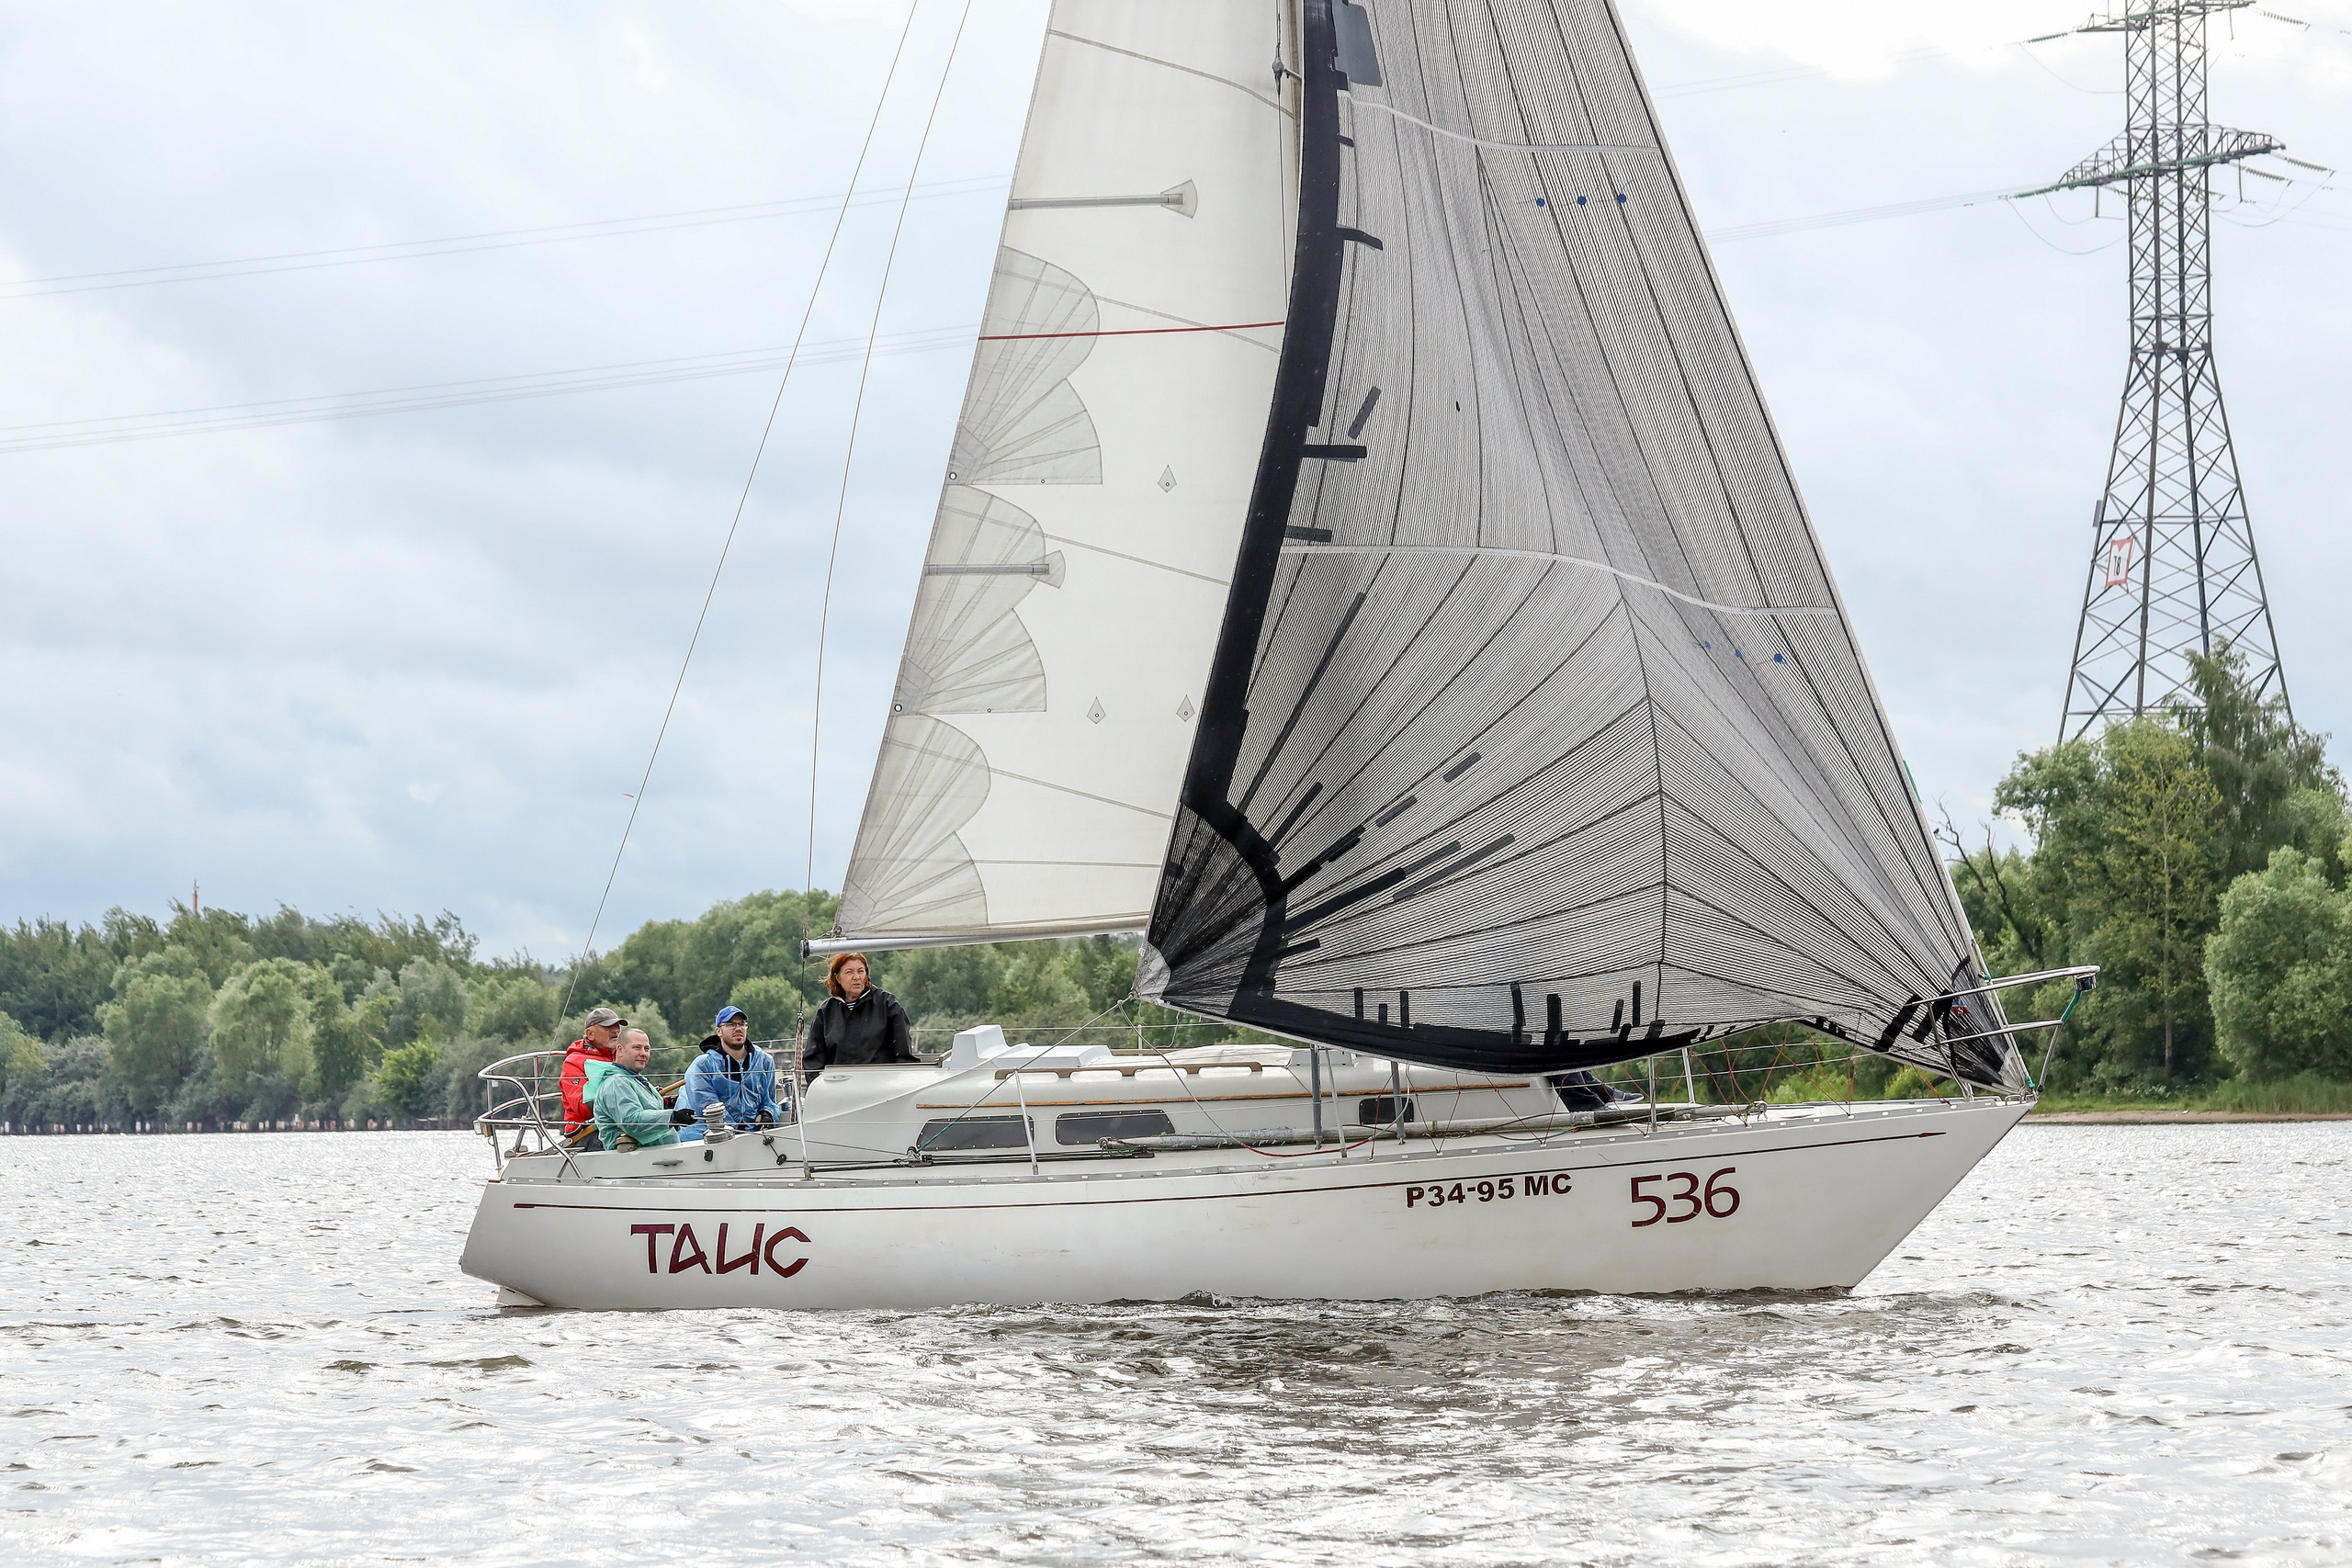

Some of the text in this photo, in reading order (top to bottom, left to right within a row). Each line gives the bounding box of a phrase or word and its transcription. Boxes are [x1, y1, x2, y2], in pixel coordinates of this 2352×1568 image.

[2113, 555, 2121, 576] 18
[1406, 1173, 1573, 1208] Р34-95 МС
[1630, 1167, 1741, 1227] 536
[630, 1223, 812, 1278] ТАИС
